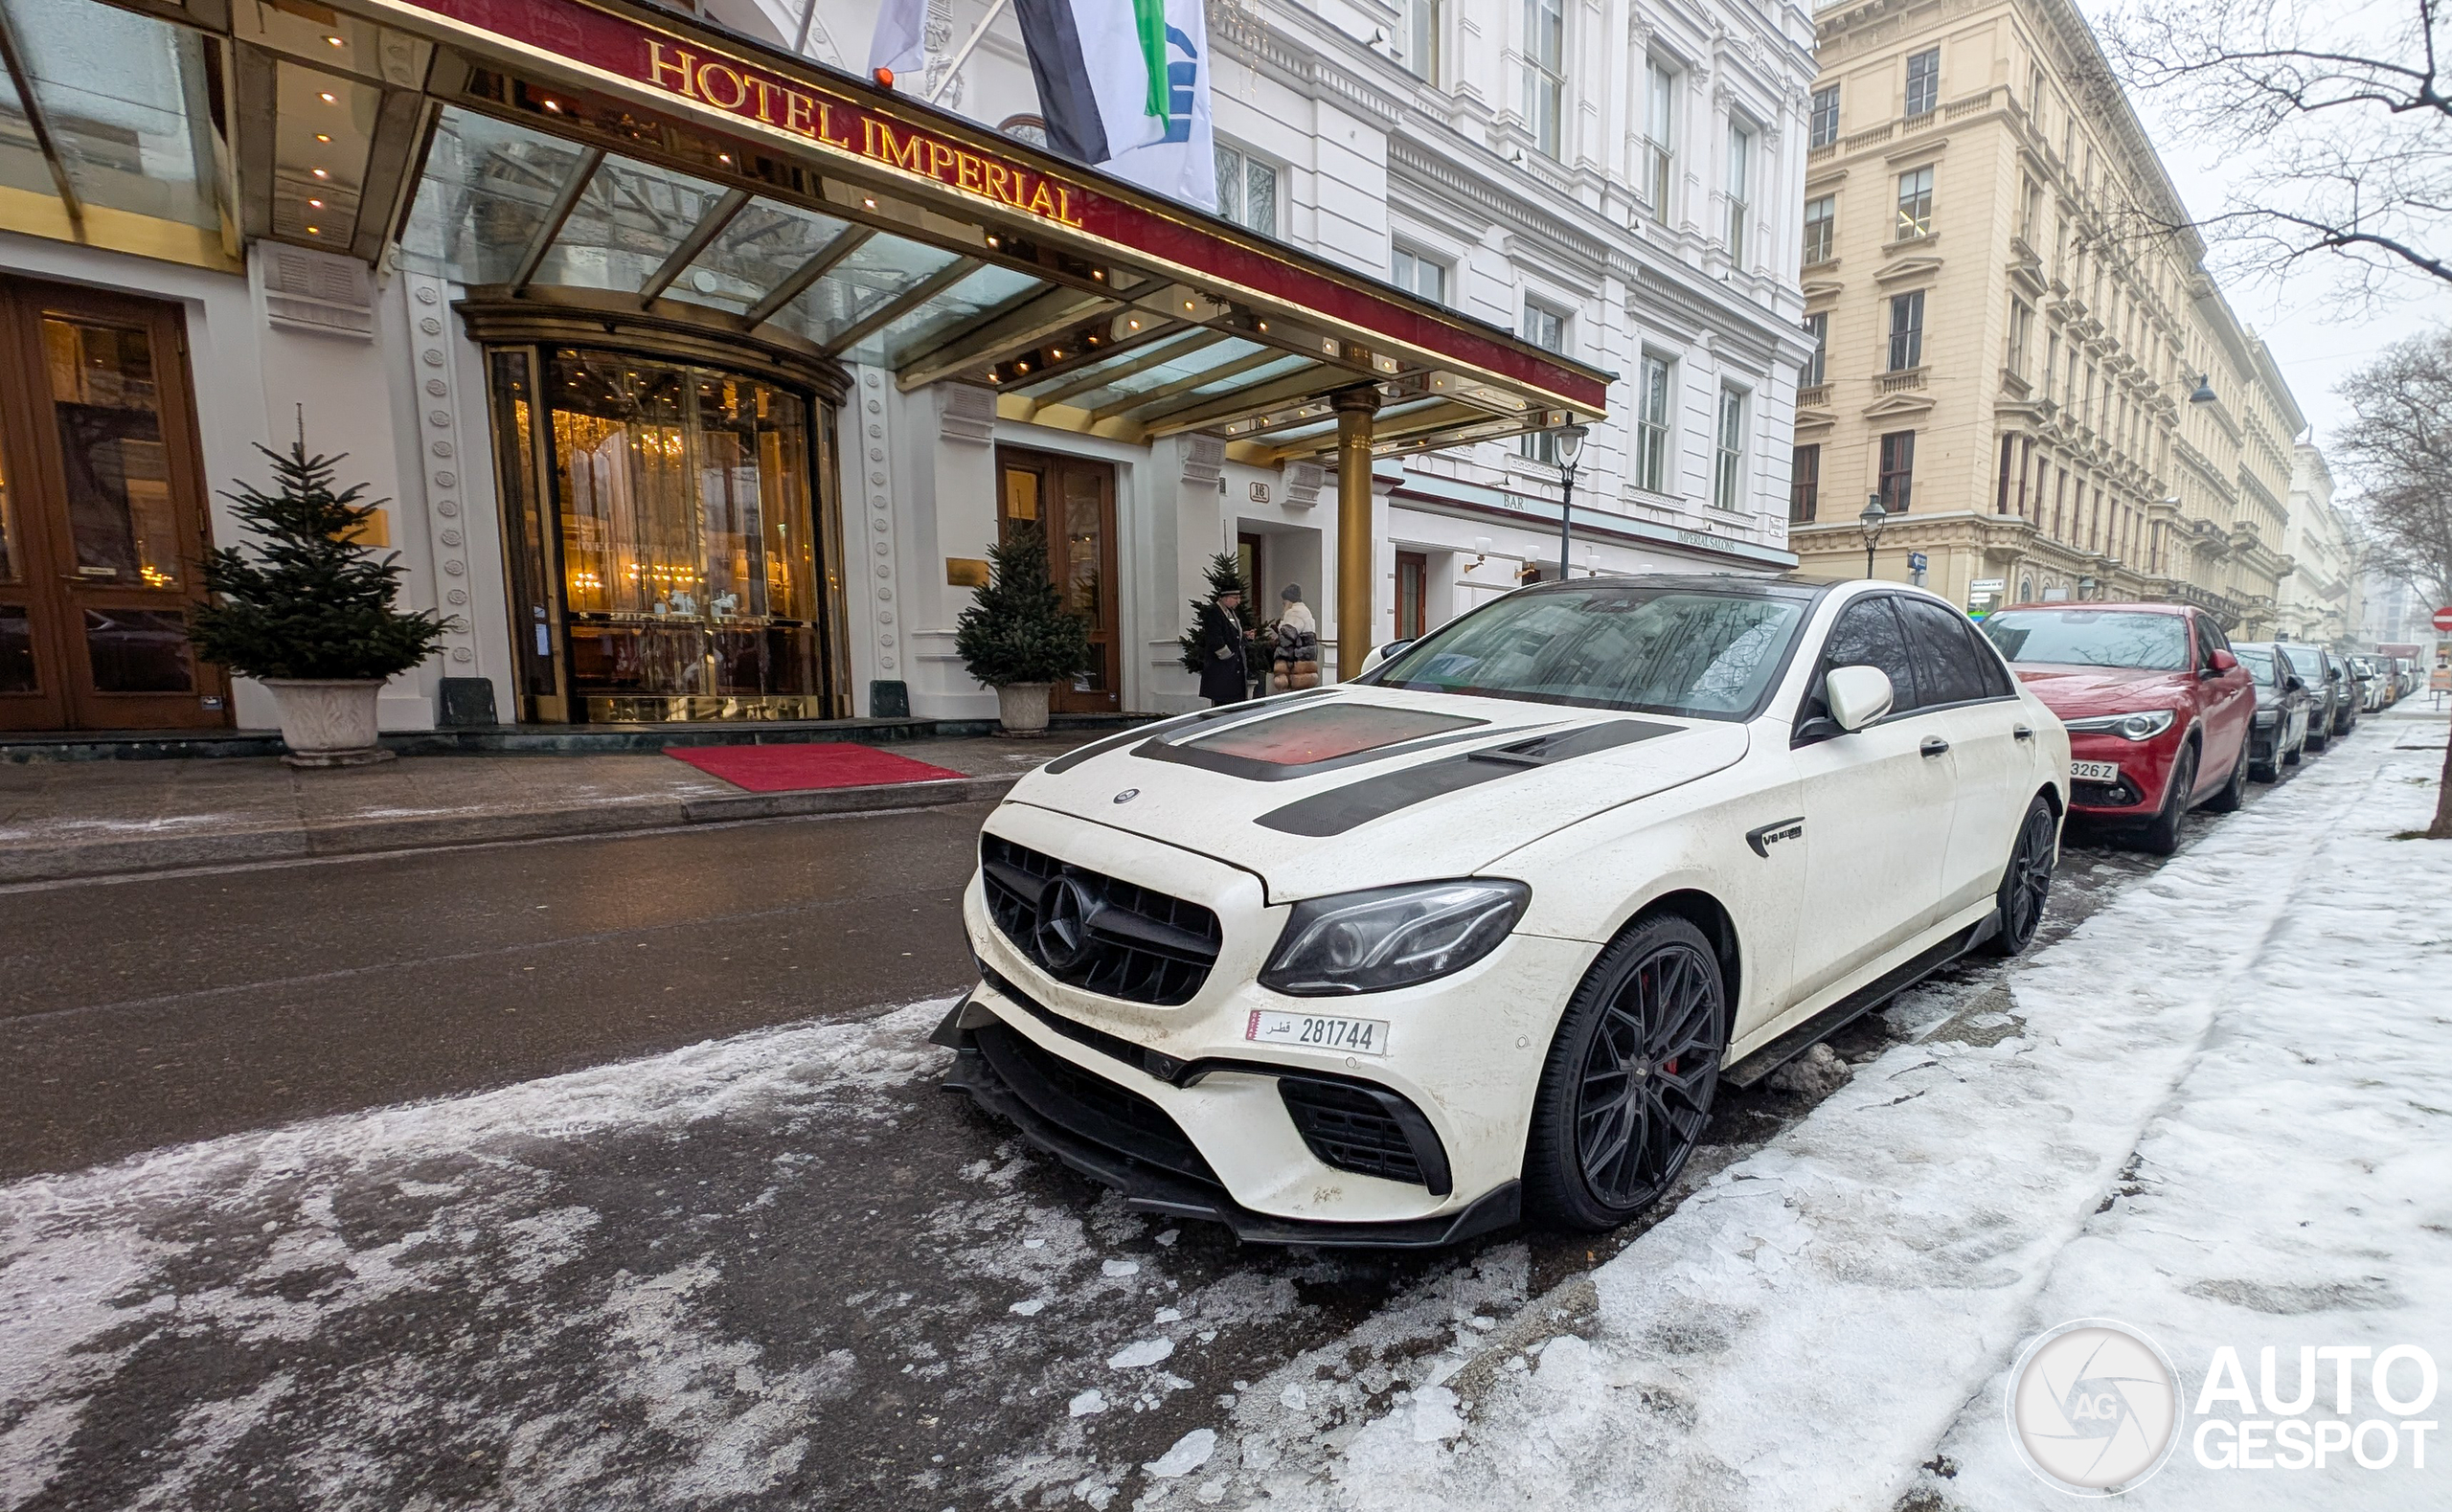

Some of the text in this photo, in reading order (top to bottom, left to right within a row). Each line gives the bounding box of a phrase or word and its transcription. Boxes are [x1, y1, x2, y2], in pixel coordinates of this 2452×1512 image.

[643, 38, 1083, 228] HOTEL IMPERIAL
[1255, 485, 1264, 497] 16
[1504, 494, 1524, 510] BAR
[1677, 531, 1735, 552] IMPERIAL SALONS
[2101, 765, 2112, 778] Z
[1763, 833, 1778, 846] V8
[1265, 1021, 1290, 1035] قطر
[1300, 1018, 1373, 1049] 281744
